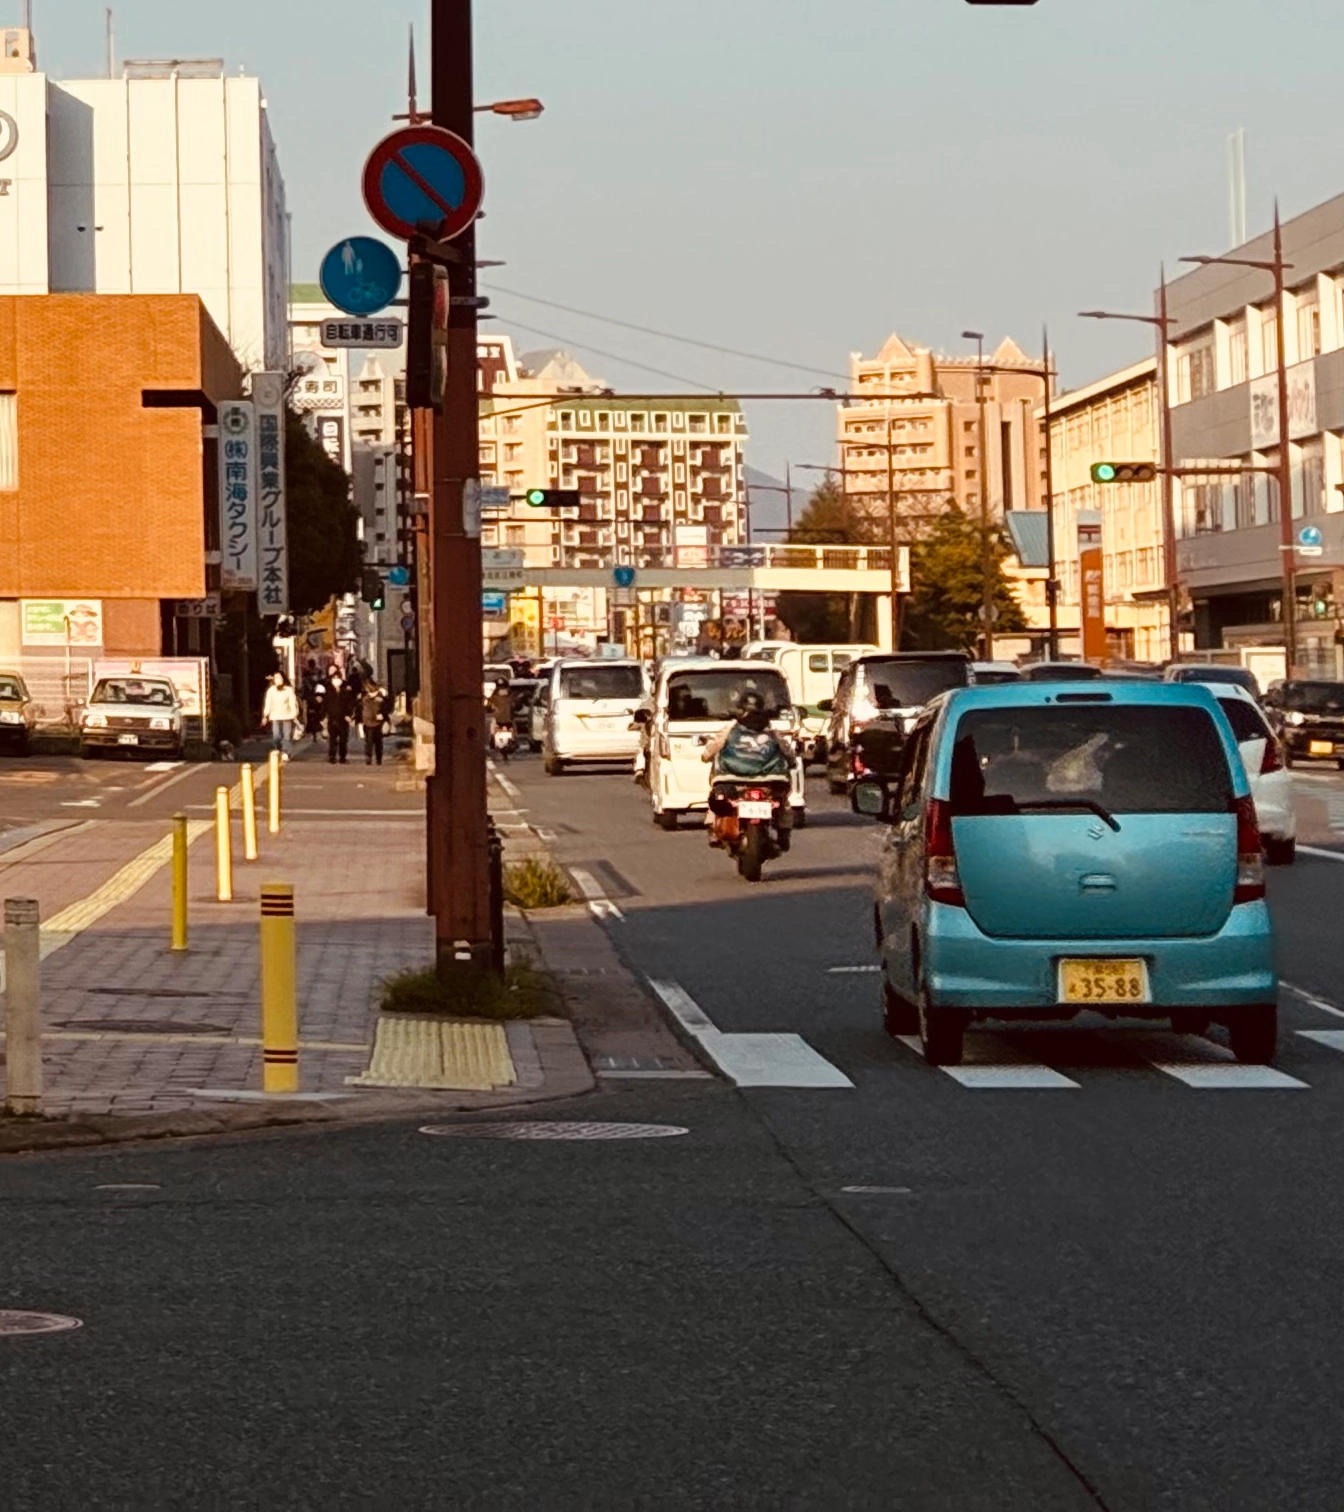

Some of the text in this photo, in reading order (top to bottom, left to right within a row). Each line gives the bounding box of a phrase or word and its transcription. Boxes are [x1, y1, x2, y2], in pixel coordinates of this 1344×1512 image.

[326, 324, 399, 341] 自転車通行可
